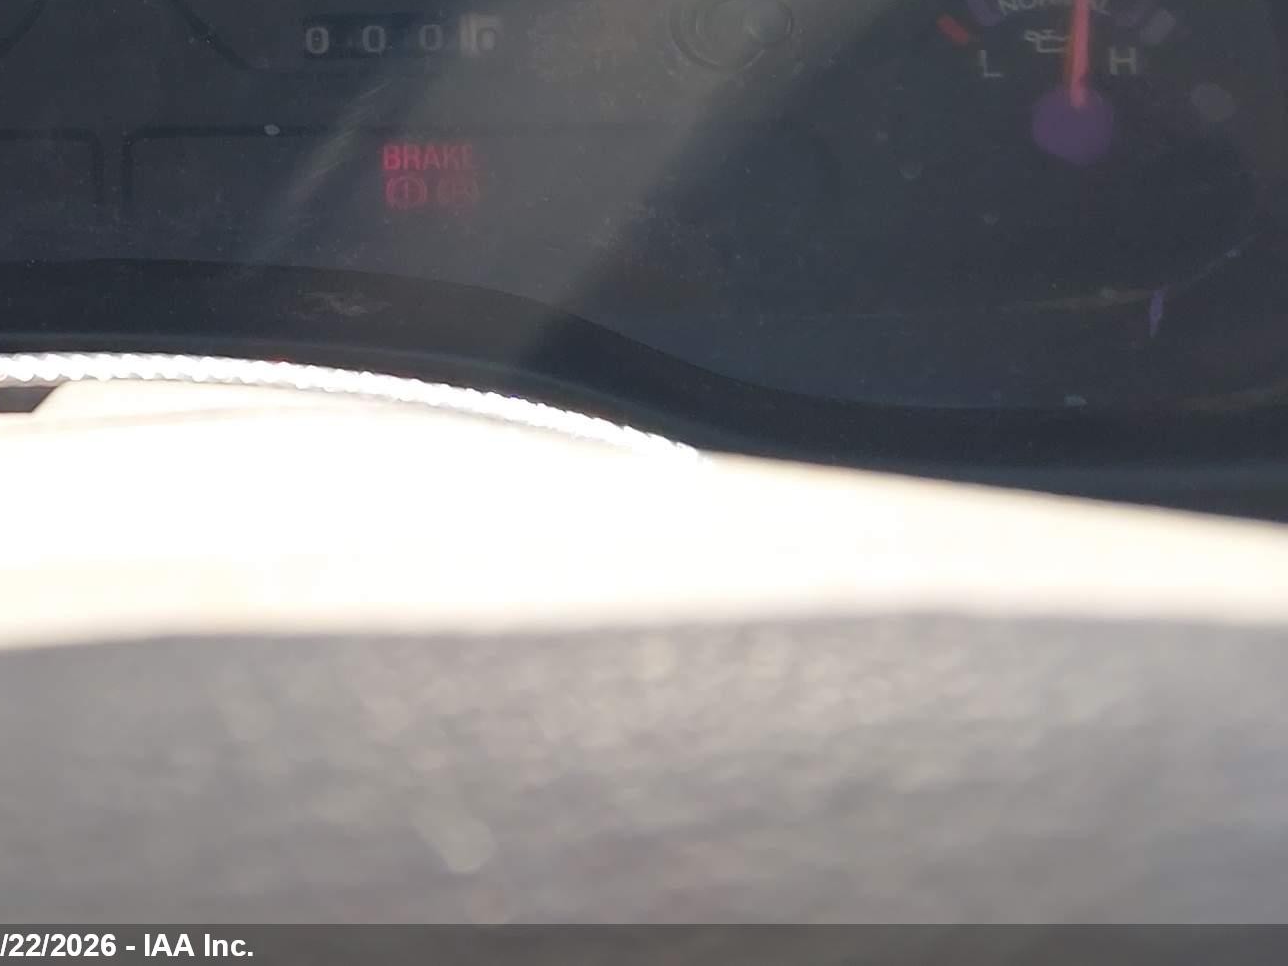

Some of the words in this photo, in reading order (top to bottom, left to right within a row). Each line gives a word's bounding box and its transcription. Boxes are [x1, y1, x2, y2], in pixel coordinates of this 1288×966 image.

[978, 49, 1003, 78] L
[1108, 45, 1137, 75] H
[383, 143, 478, 170] BRAKE
